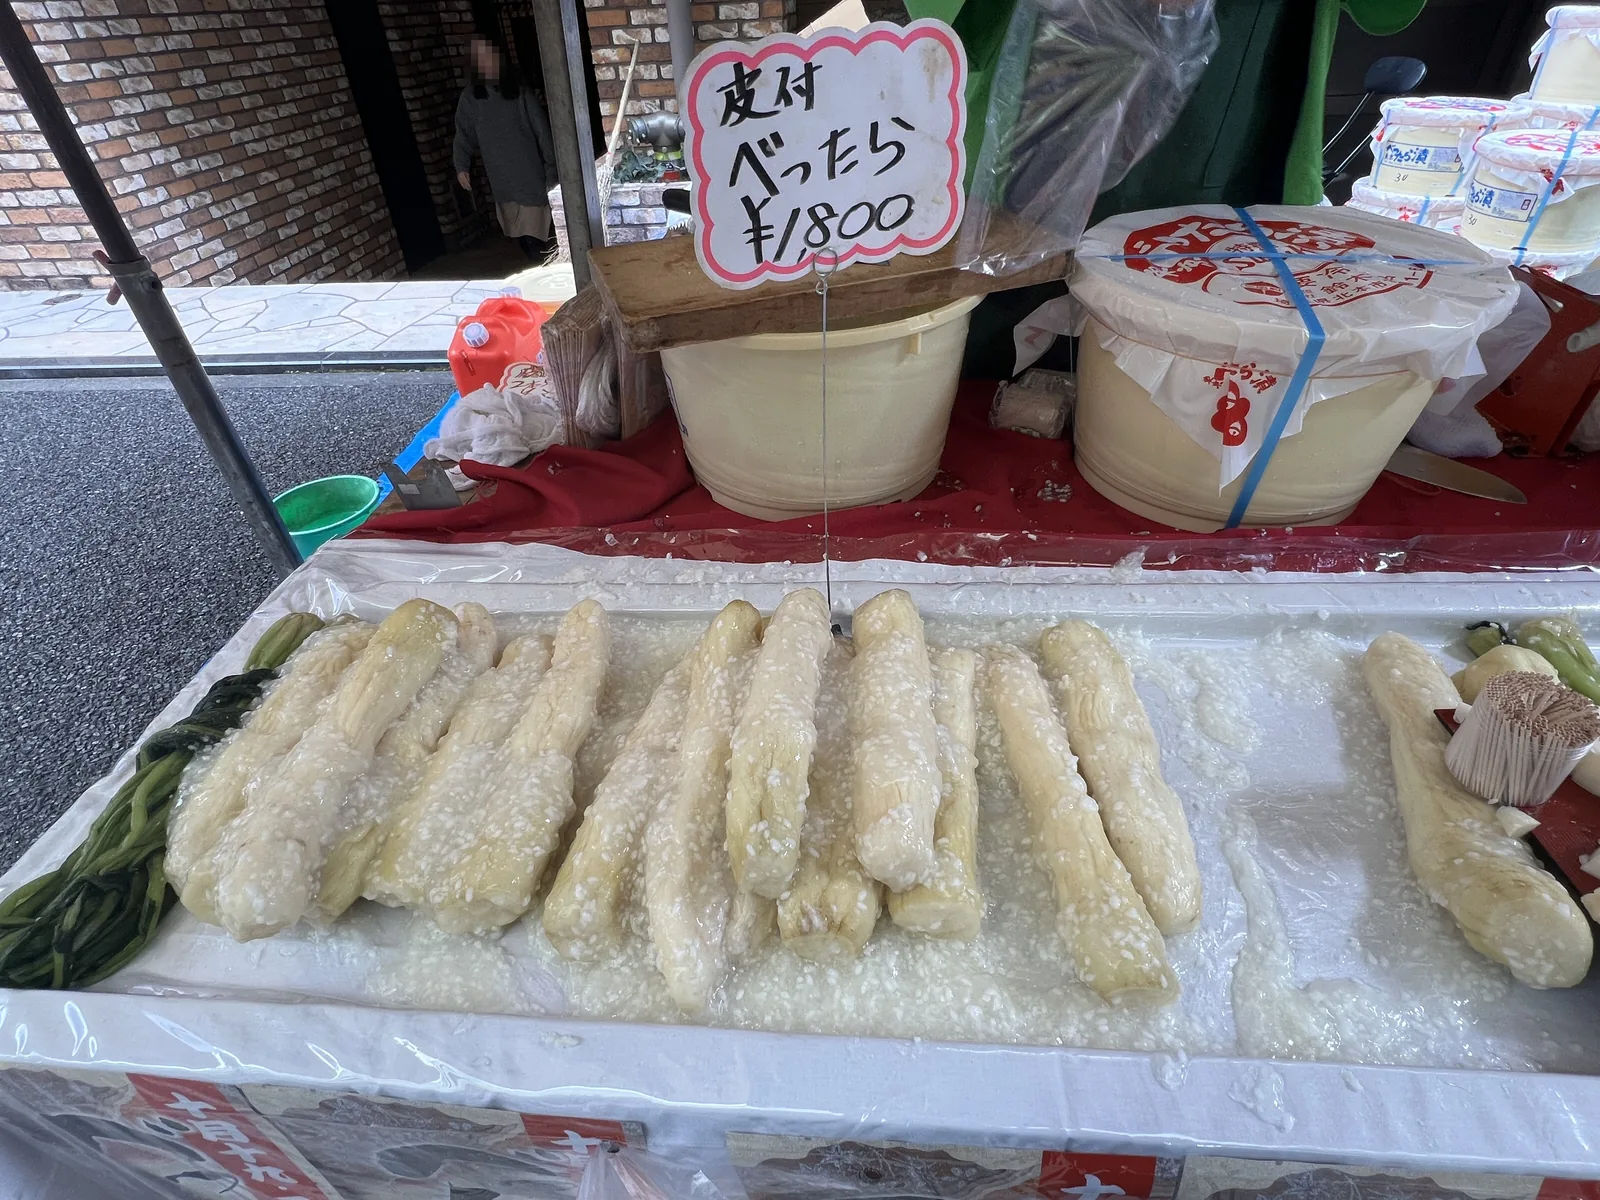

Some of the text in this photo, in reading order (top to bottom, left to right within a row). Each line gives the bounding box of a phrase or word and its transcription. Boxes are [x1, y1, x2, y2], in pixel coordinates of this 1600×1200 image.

[717, 61, 822, 127] 皮付
[729, 117, 915, 197] べったら
[740, 193, 915, 264] ¥1,800
